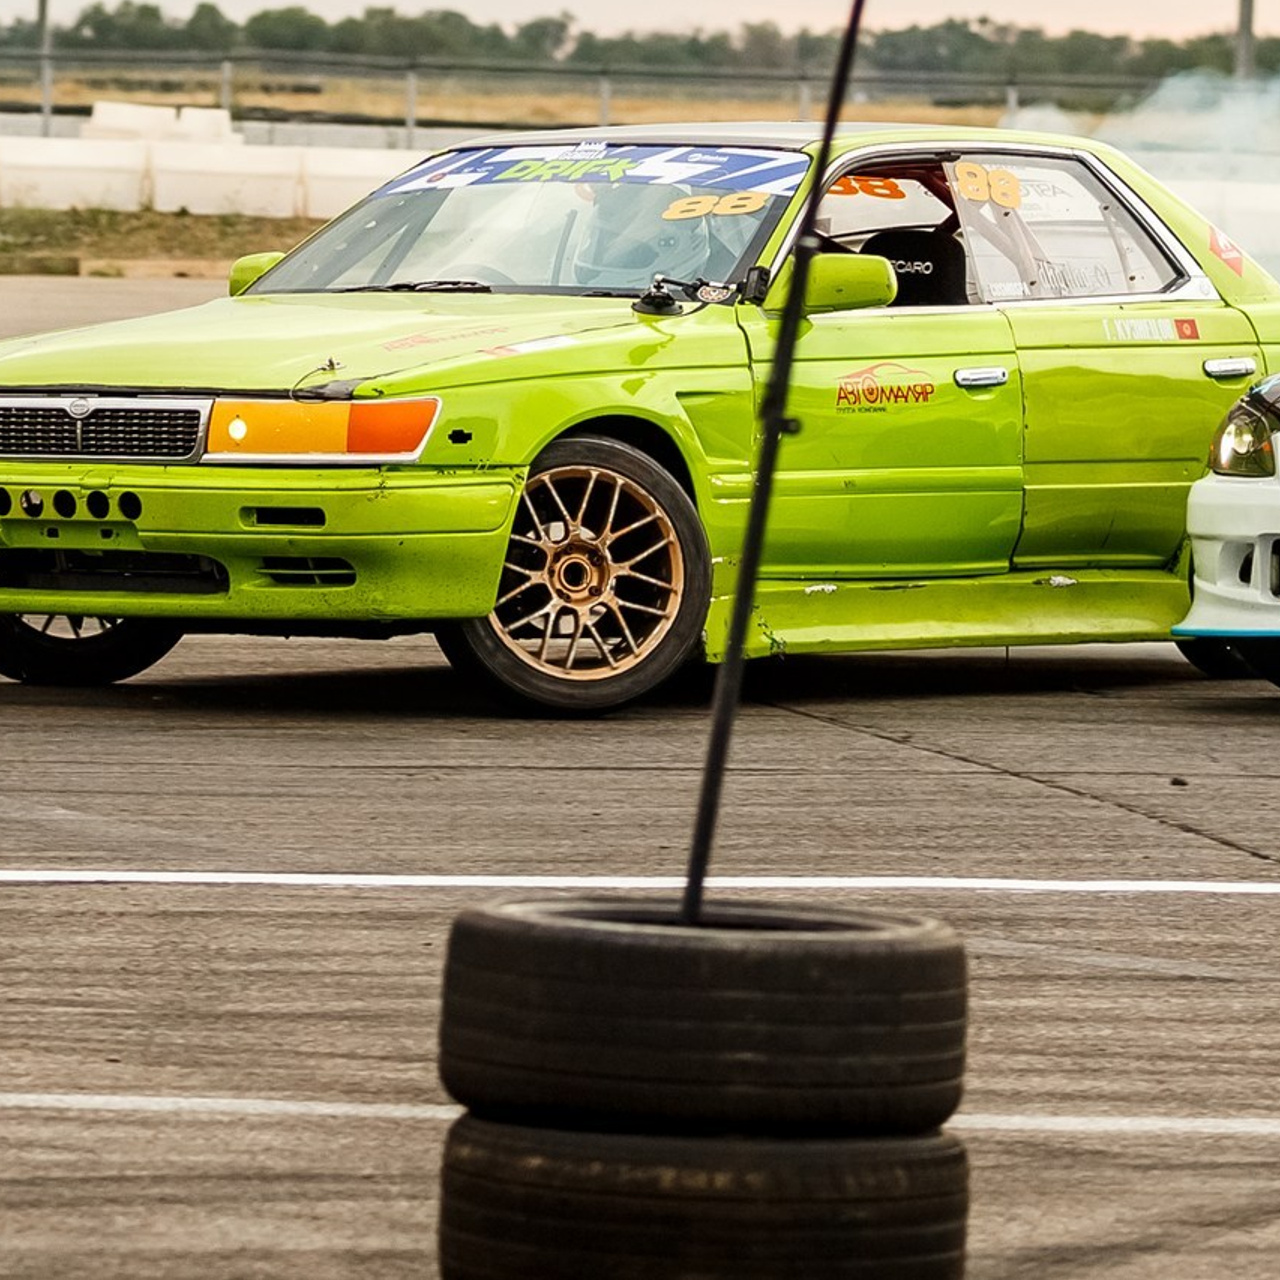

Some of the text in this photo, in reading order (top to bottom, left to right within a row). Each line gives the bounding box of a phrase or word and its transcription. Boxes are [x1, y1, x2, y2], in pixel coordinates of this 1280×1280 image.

[492, 158, 642, 181] DRIFT
[954, 161, 1022, 210] 88
[661, 192, 771, 220] 88
